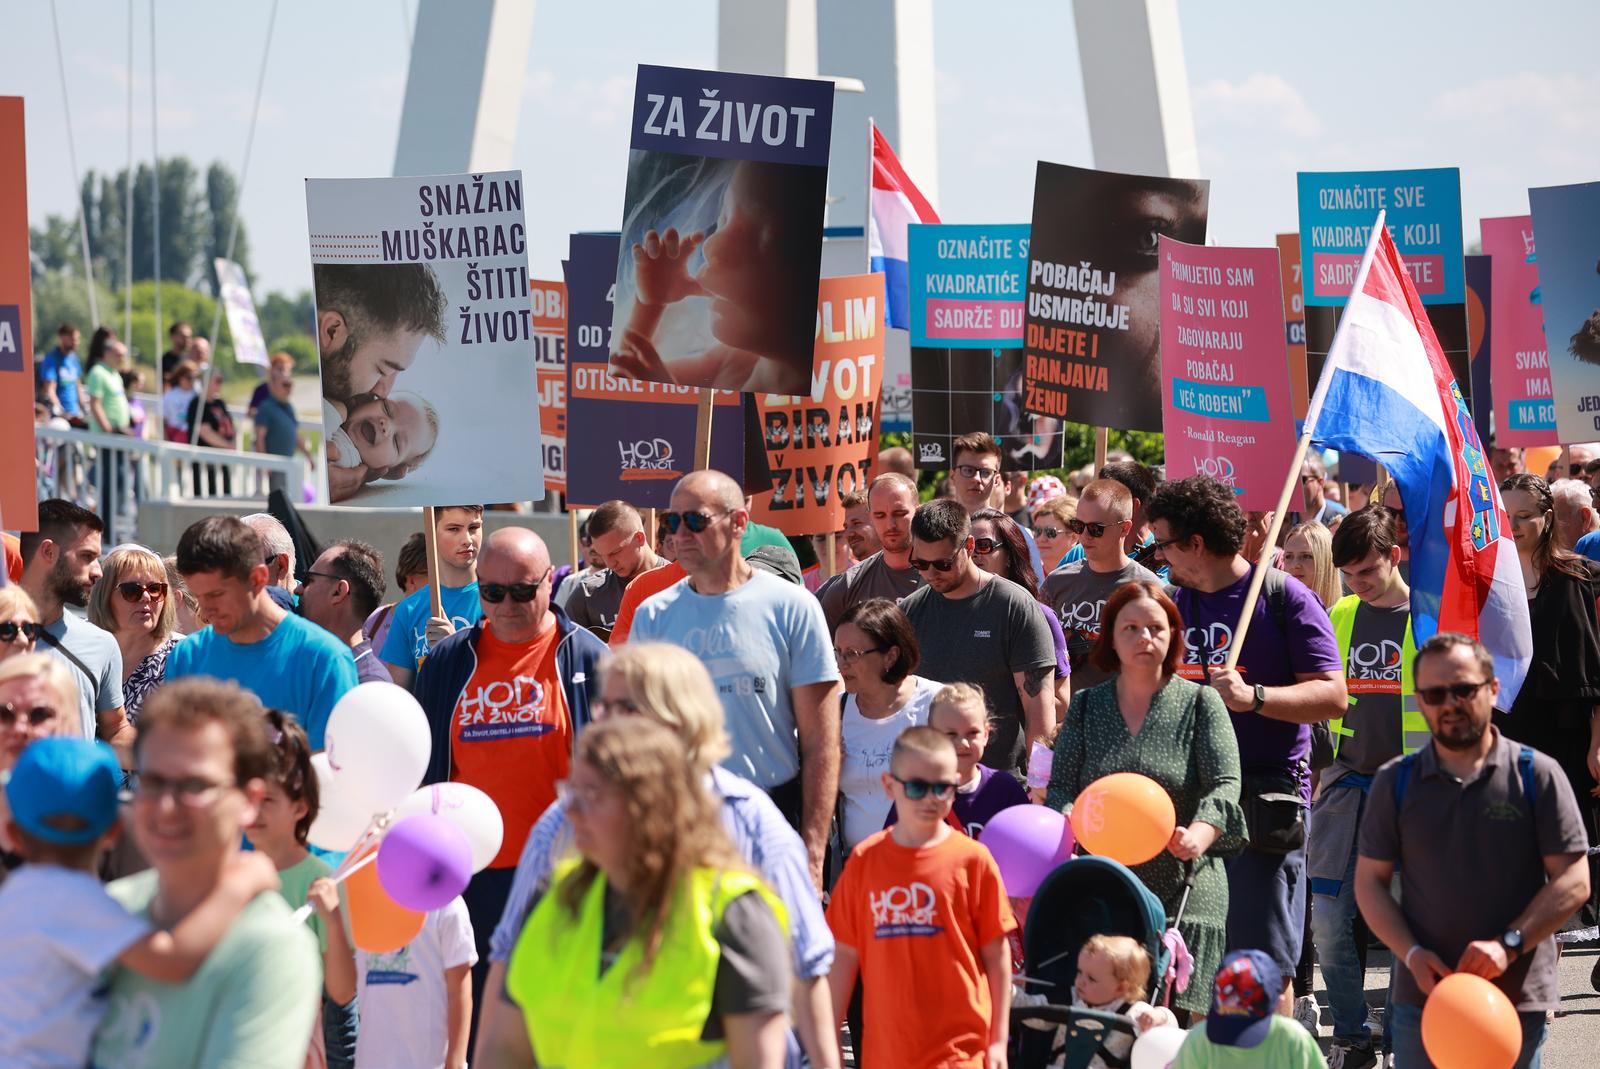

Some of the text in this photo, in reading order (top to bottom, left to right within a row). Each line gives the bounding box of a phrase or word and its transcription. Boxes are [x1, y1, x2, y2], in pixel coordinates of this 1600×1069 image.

[644, 88, 815, 148] ZA ŽIVOT
[418, 175, 522, 217] SNAŽAN
[1319, 184, 1426, 210] OZNAČITE SVE
[381, 222, 525, 261] MUŠKARAC
[937, 235, 1030, 260] OZNAČITE S
[1312, 223, 1441, 248] KVADRAT KOJI
[466, 262, 527, 300] ŠTITI
[926, 270, 1019, 294] KVADRATIĆE
[1030, 259, 1116, 296] POBAČAJ
[1226, 268, 1255, 287] SAM
[1320, 260, 1362, 286] SADRŽ
[934, 305, 1023, 329] SADRŽE DIJ
[1028, 292, 1130, 331] USMRĆUJE
[1172, 292, 1249, 319] DA SU SVI KOJI
[460, 306, 530, 344] ŽIVOT
[815, 296, 876, 344] LIM
[578, 325, 603, 348] OD
[1027, 323, 1099, 359] DIJETE I
[1178, 325, 1243, 350] ZAGOVARAJU
[1026, 354, 1109, 392] RANJAVA
[1187, 359, 1234, 382] POBAČAJ
[1516, 351, 1550, 370] SVAK
[1025, 379, 1068, 417] ŽENU
[1180, 388, 1196, 410] VEĆ
[1526, 378, 1552, 397] IMA
[765, 401, 874, 451] BIRAM
[1519, 406, 1535, 424] NA
[618, 438, 673, 462] HOD
[1217, 430, 1256, 448] Reagan
[1181, 622, 1232, 654] OD
[461, 675, 544, 715] HOD
[870, 882, 936, 914] HOD
